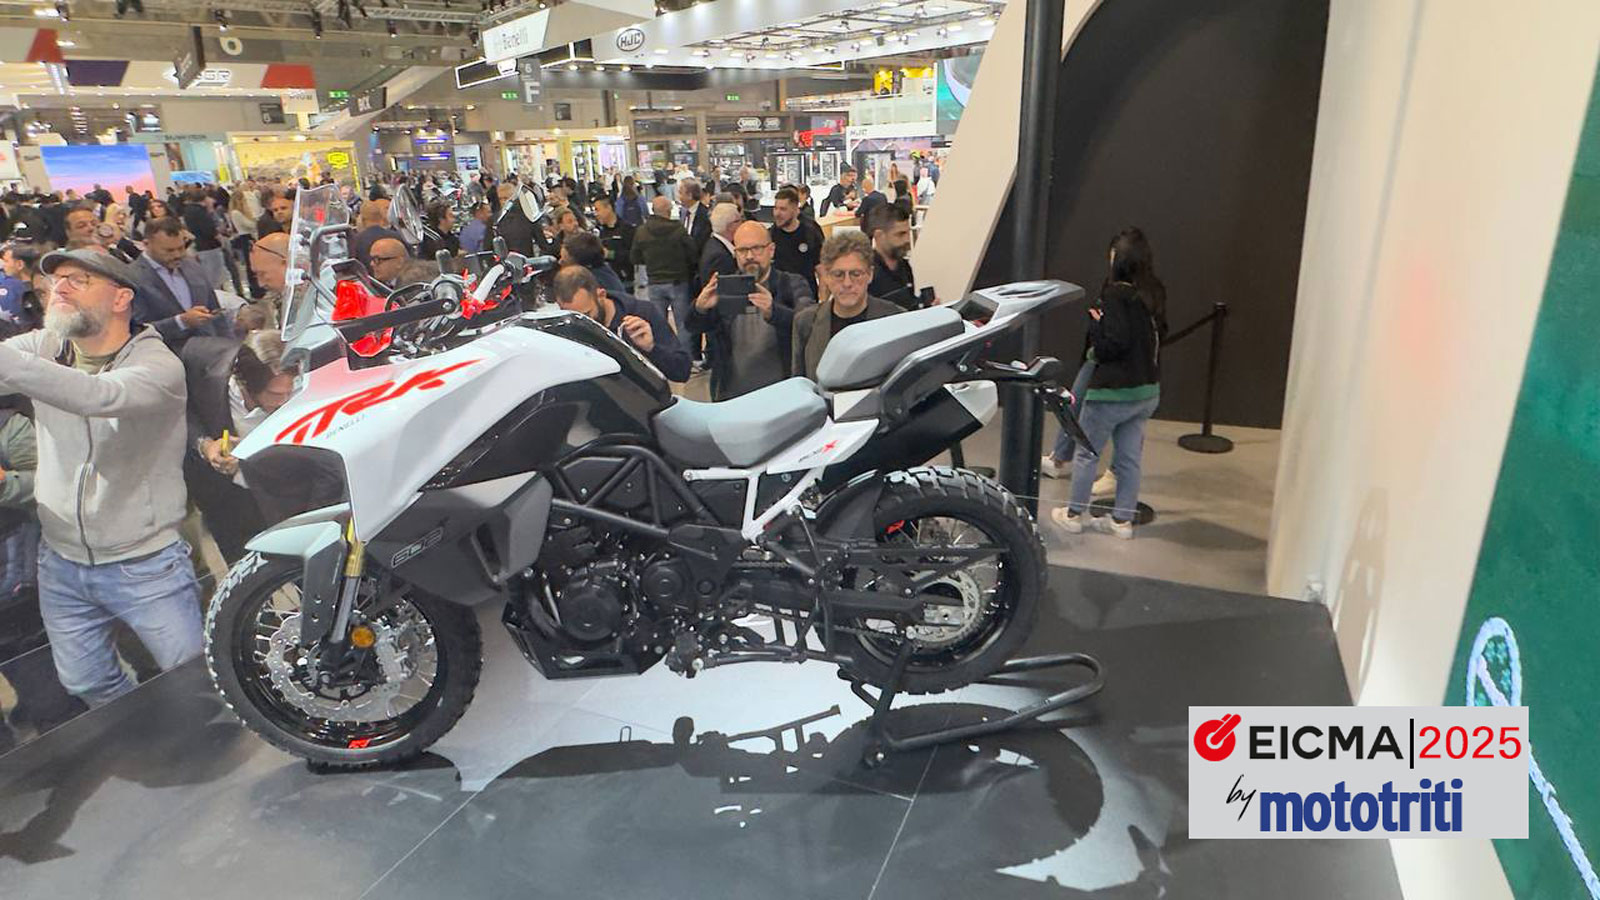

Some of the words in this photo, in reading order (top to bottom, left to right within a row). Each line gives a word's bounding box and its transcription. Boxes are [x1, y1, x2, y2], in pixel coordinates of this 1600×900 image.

[620, 32, 641, 48] HJC
[525, 63, 533, 73] 6
[525, 81, 541, 103] F
[274, 358, 483, 445] TRK
